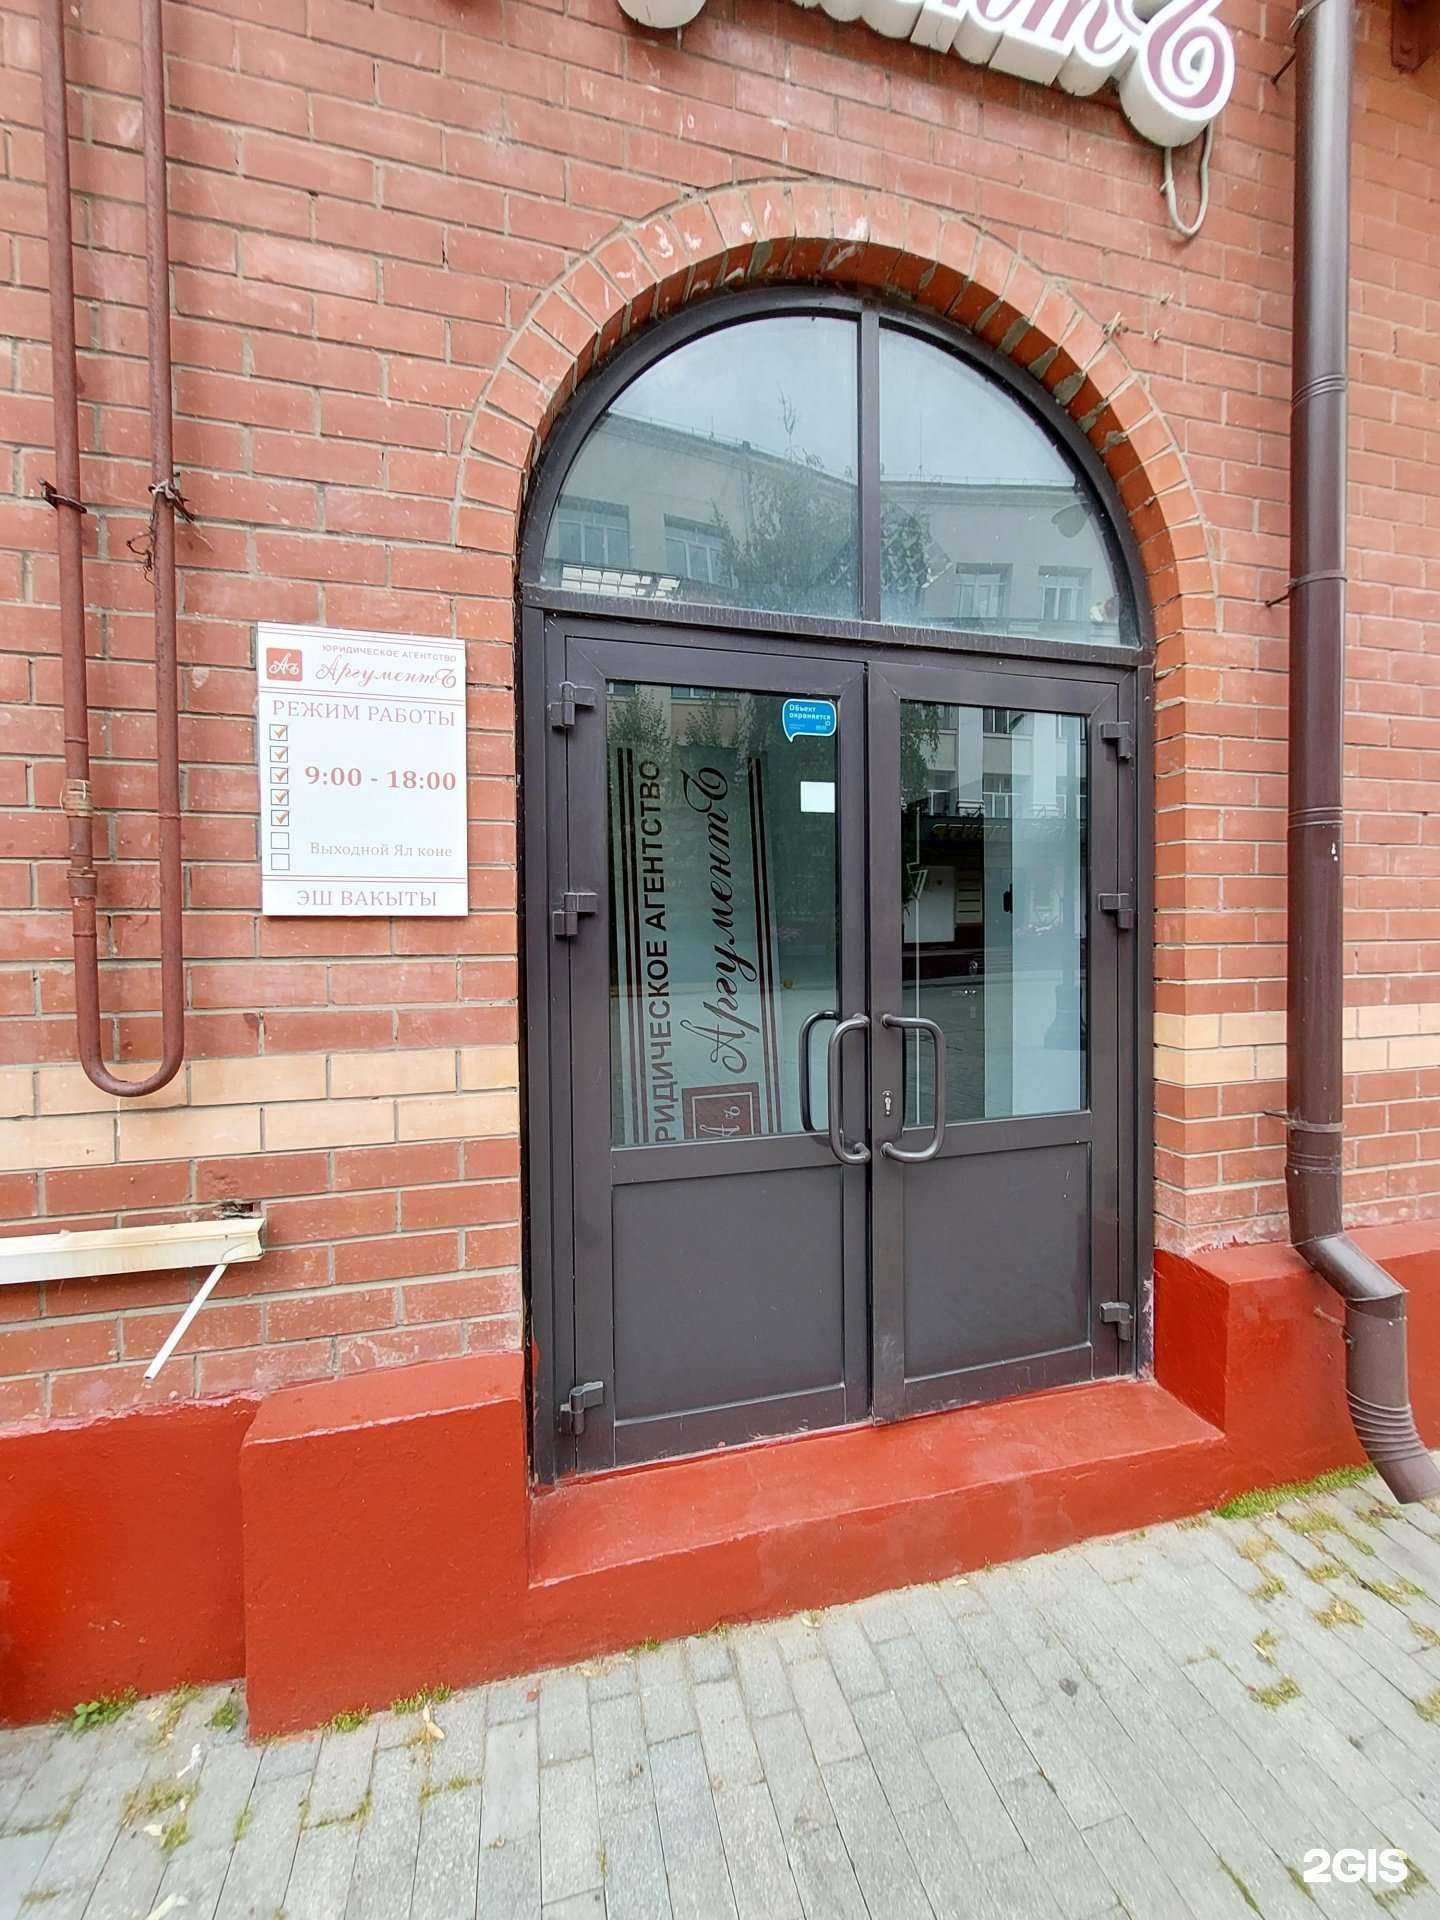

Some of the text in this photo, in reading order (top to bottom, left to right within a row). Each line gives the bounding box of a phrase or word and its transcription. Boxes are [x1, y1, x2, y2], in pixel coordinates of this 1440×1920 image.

[322, 644, 457, 662] ЮРИДИЧЕСКОЕ АГЕНТСТВО
[272, 699, 456, 727] РЕЖИМ РАБОТЫ
[304, 766, 362, 787] 9:00
[386, 769, 456, 791] 18:00
[310, 841, 390, 857] Выходной
[296, 890, 437, 908] ЭШ ВАКЫТЫ
[639, 759, 677, 1142] РИДИЧЕСКОЕ АГЕНТСТВО
